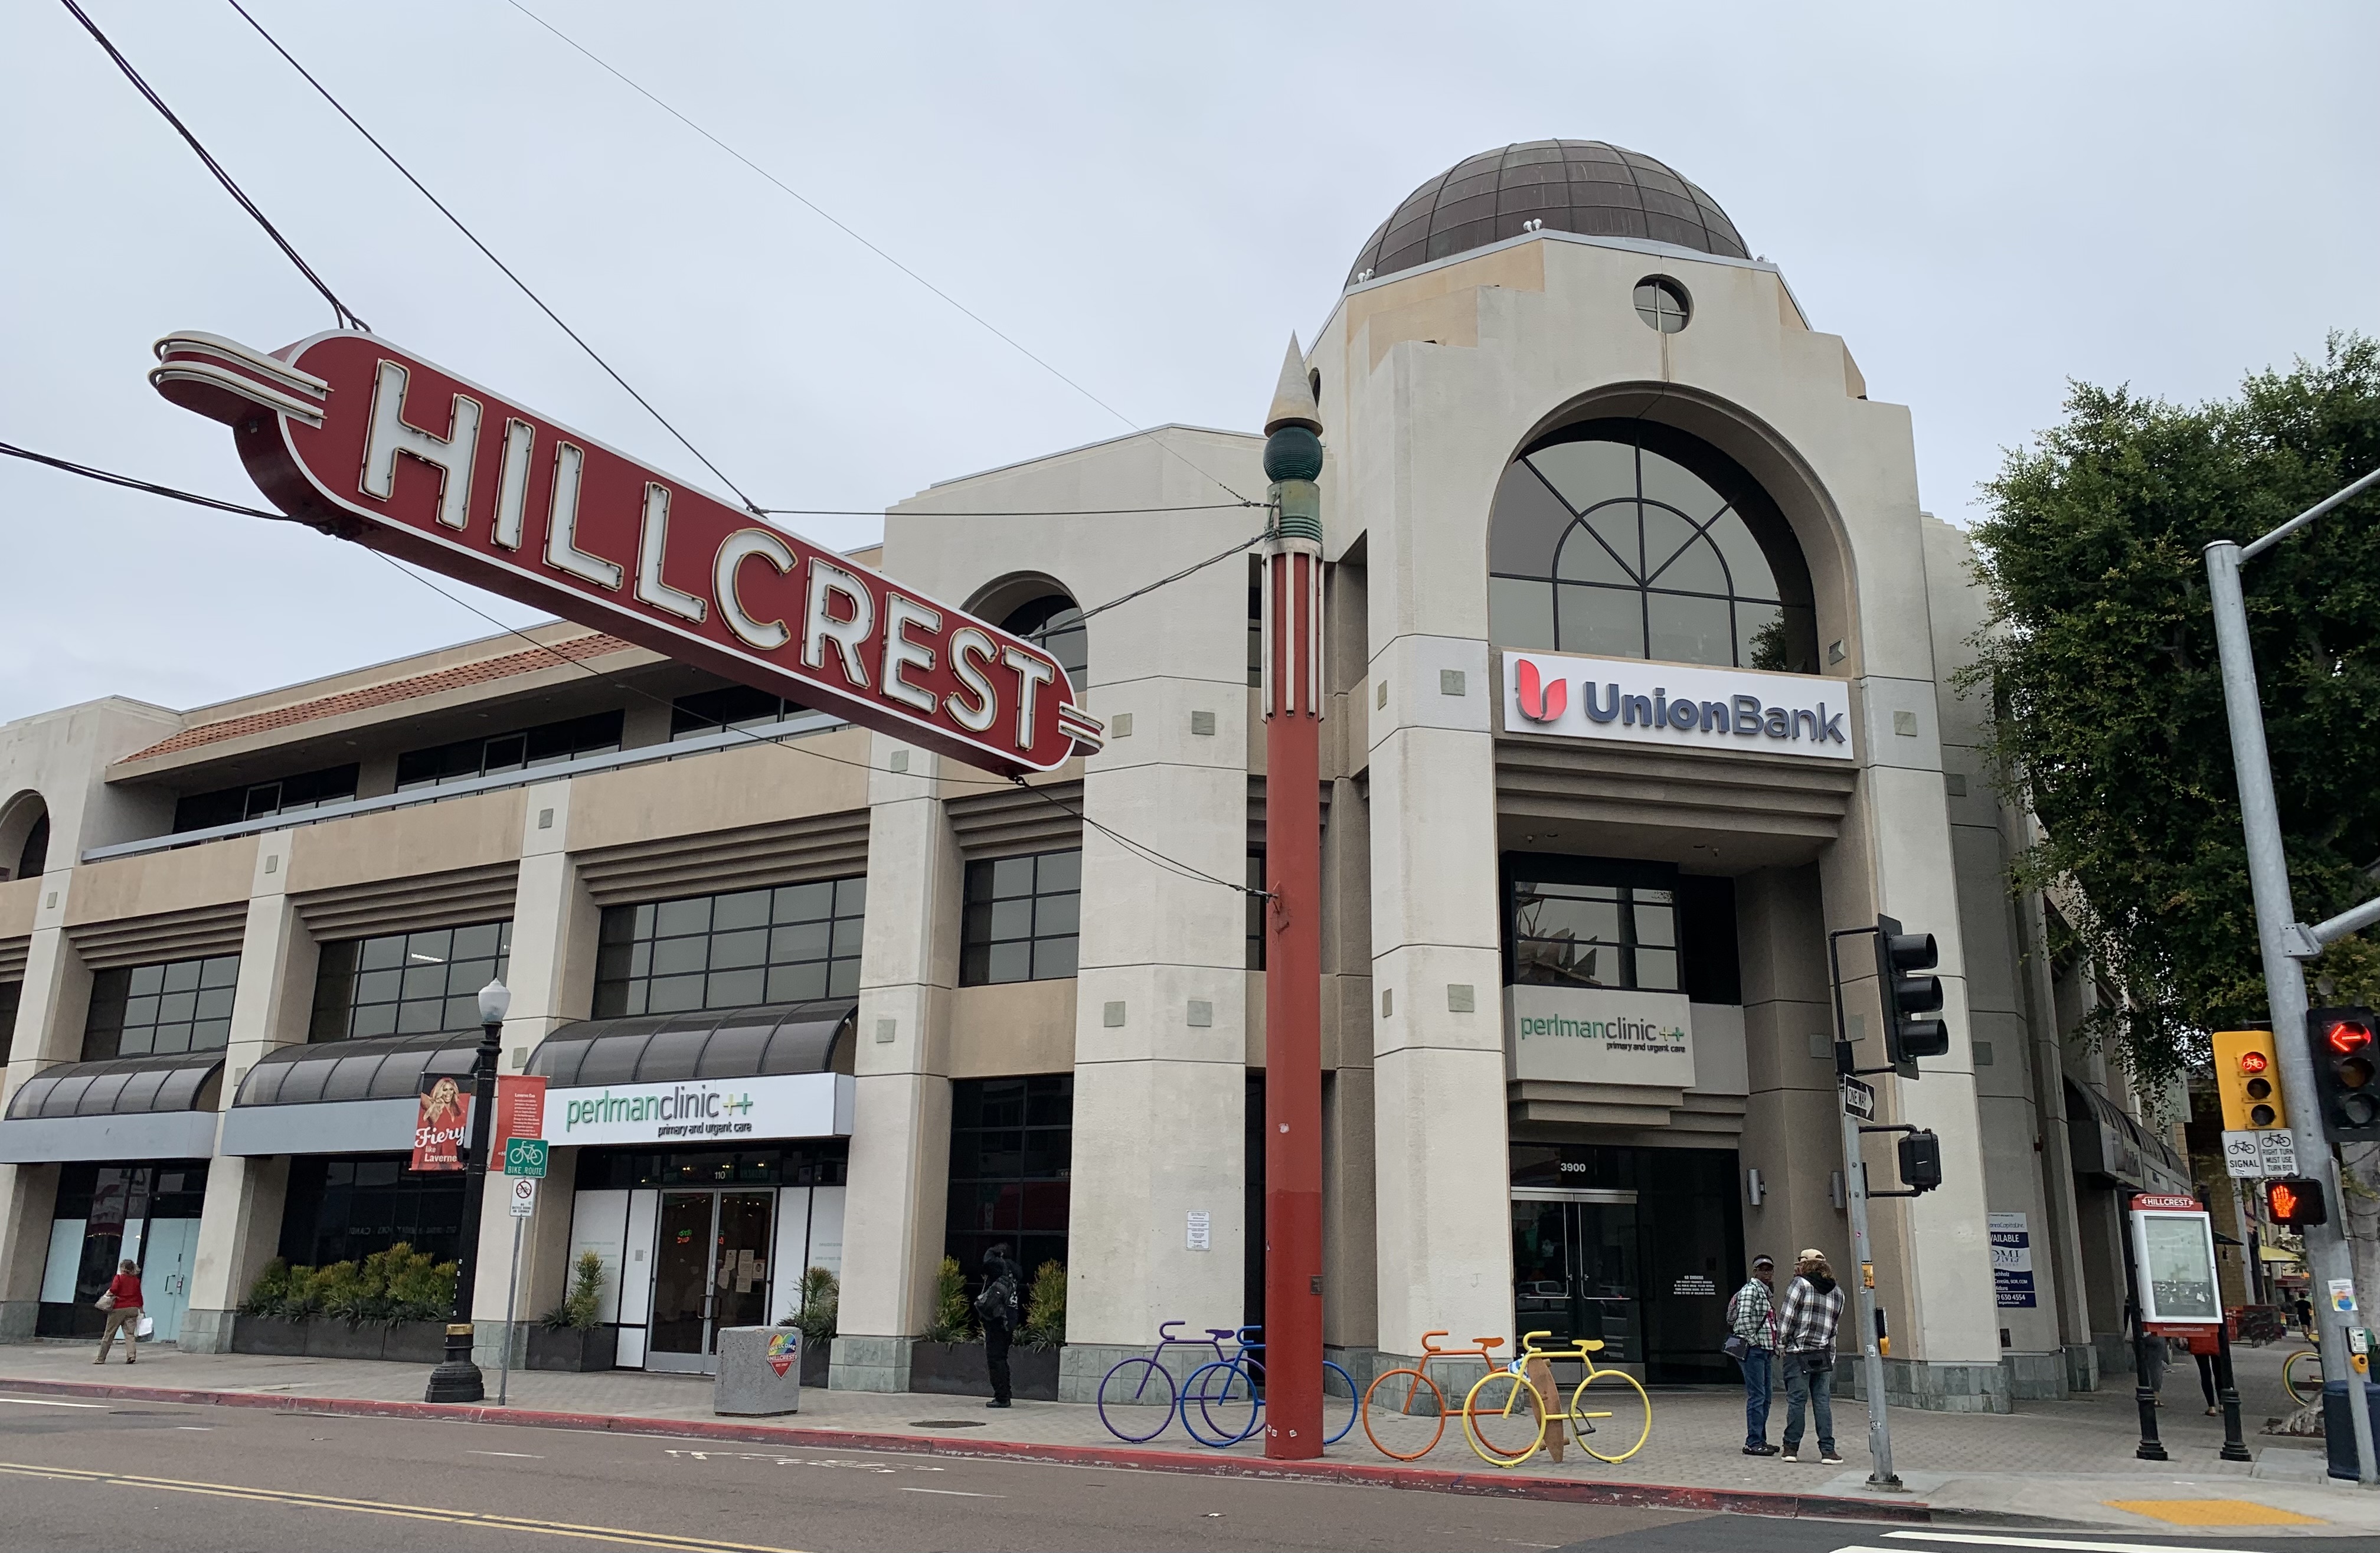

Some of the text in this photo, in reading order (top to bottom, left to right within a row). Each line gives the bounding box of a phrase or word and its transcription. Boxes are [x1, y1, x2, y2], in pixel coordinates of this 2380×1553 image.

[358, 358, 1055, 750] HILLCREST
[1583, 681, 1846, 743] UnionBank
[1607, 1041, 1632, 1051] primary
[1647, 1044, 1669, 1053] urgent
[1849, 1088, 1858, 1104] ONE
[658, 1122, 752, 1137] primary and urgent care
[414, 1126, 465, 1148] Fiery
[424, 1153, 457, 1162] Laverne
[524, 1167, 542, 1175] ROUTE
[1561, 1163, 1586, 1172] 3900
[715, 1171, 725, 1179] 110
[1991, 1234, 2019, 1243] VAILABLE
[769, 1343, 796, 1351] WELCOME
